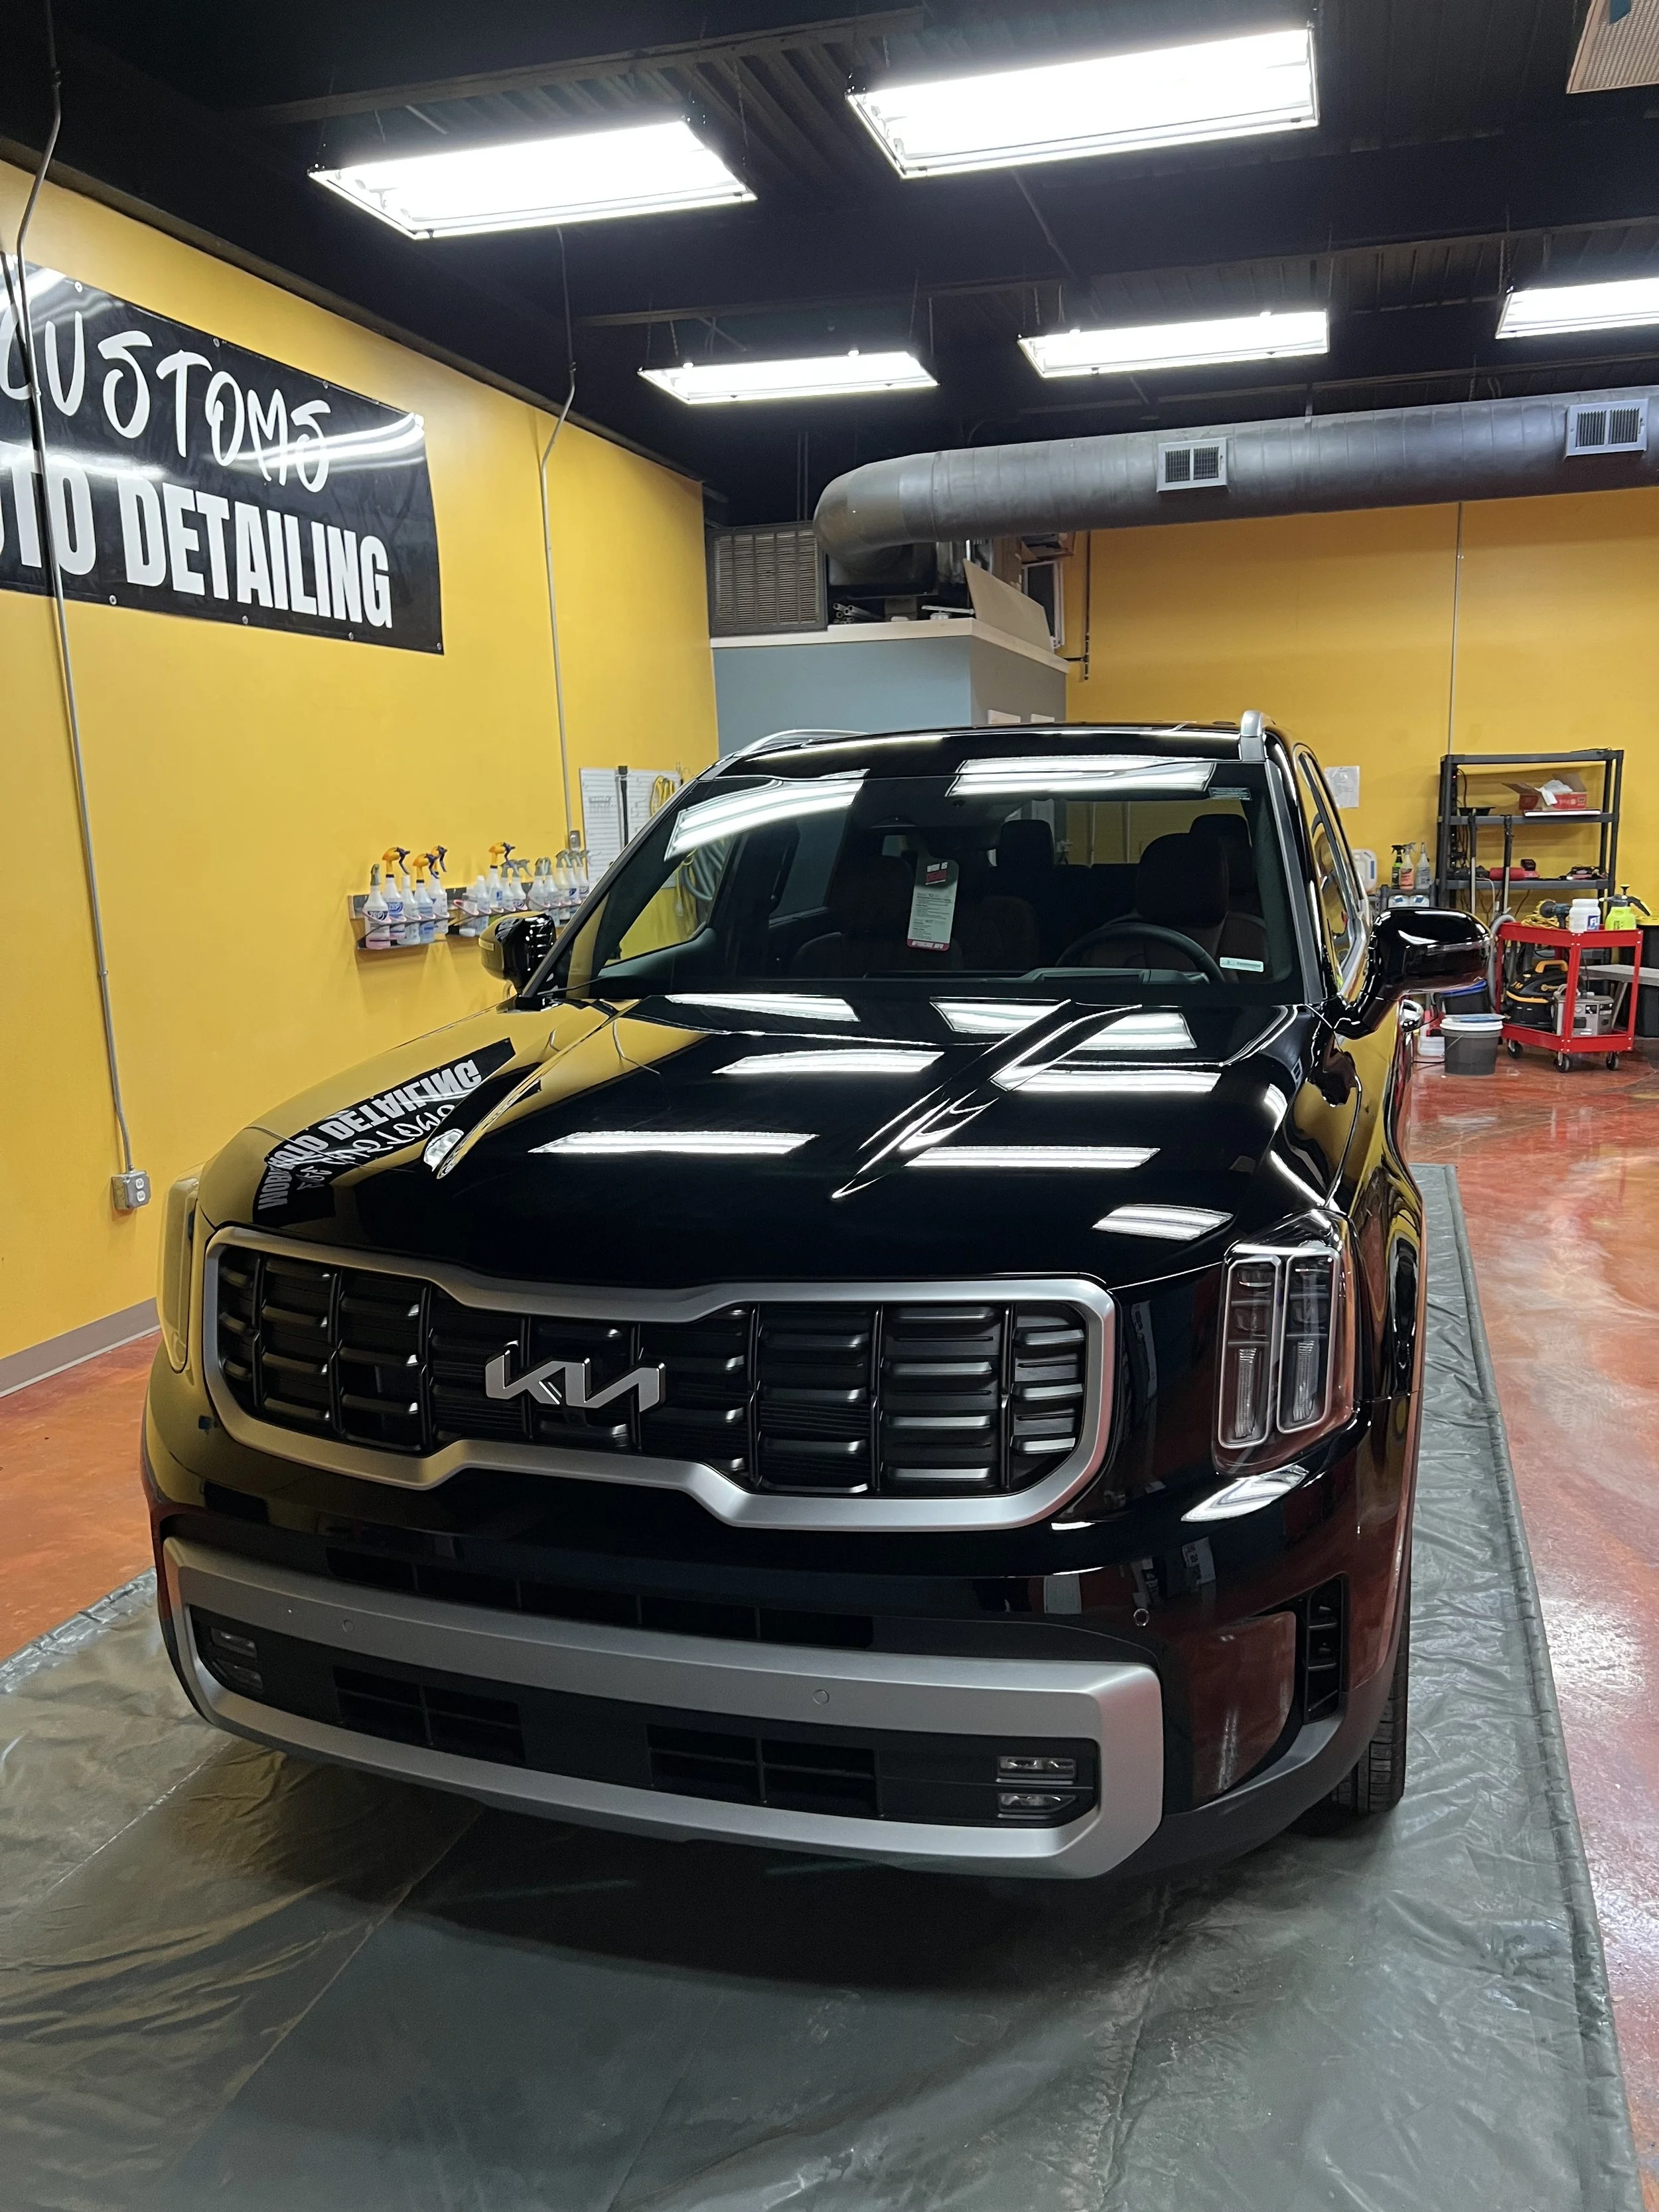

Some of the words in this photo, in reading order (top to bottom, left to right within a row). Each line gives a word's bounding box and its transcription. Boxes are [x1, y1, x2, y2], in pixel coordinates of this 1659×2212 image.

[0, 443, 96, 576] TO
[117, 474, 393, 628] DETAILING
[485, 1350, 665, 1413] KIA
